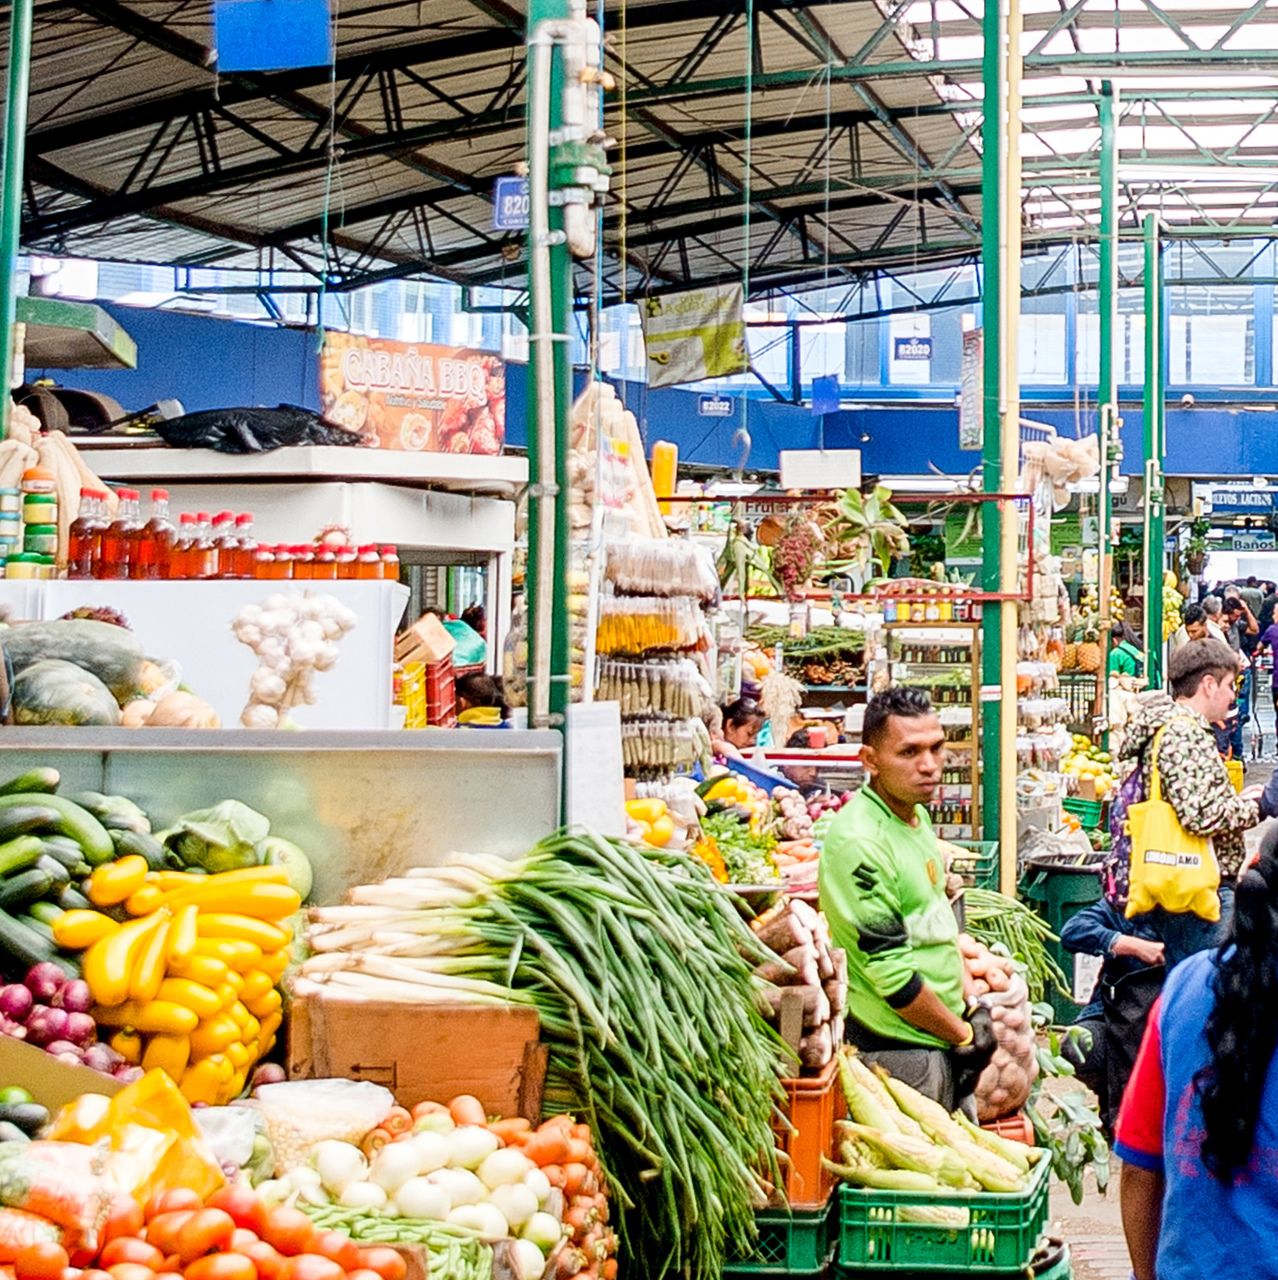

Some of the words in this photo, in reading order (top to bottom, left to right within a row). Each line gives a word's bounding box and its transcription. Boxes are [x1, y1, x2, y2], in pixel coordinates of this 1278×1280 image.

[504, 195, 530, 215] 820
[343, 347, 436, 396] CABAÑA
[437, 358, 488, 406] BBQ
[1211, 493, 1238, 505] UEVOS
